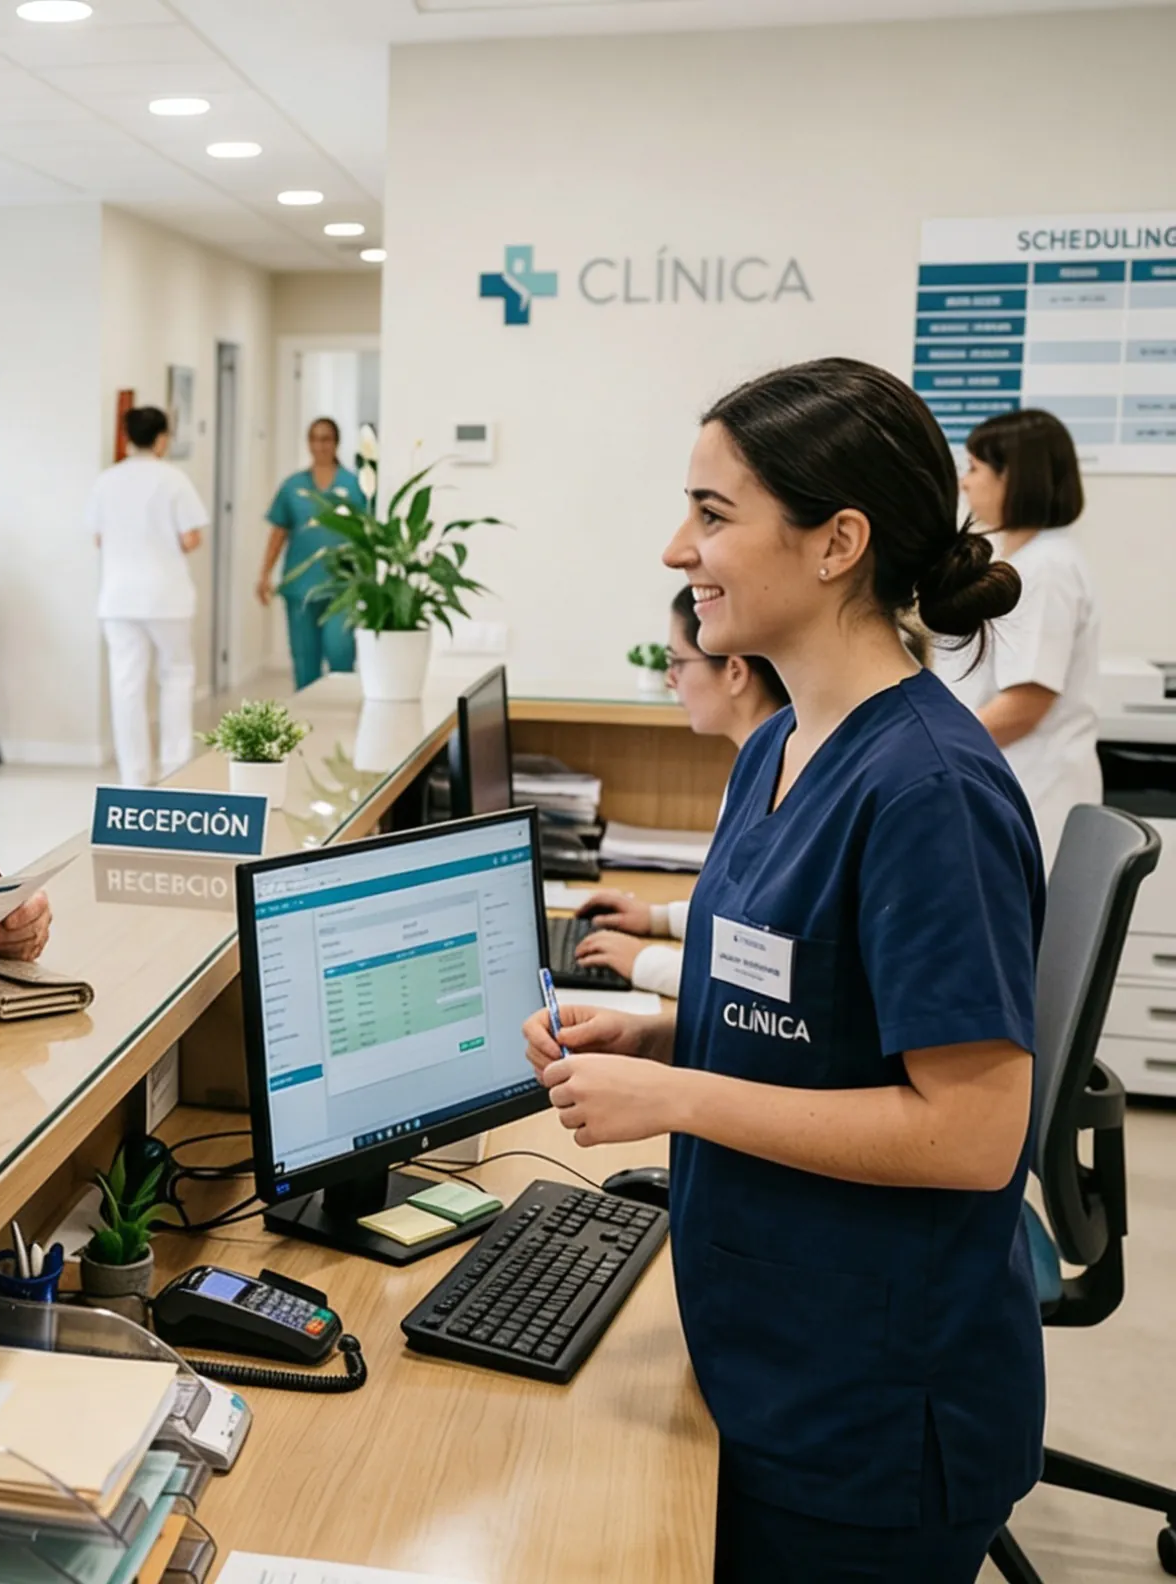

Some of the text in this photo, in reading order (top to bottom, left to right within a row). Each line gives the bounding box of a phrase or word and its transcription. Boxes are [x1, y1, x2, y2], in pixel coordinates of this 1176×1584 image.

[1017, 226, 1176, 251] SCHEDULING
[578, 246, 814, 305] CLÍNICA
[107, 806, 249, 837] RECEPCIÓN
[723, 1001, 811, 1043] CLÍNICA
